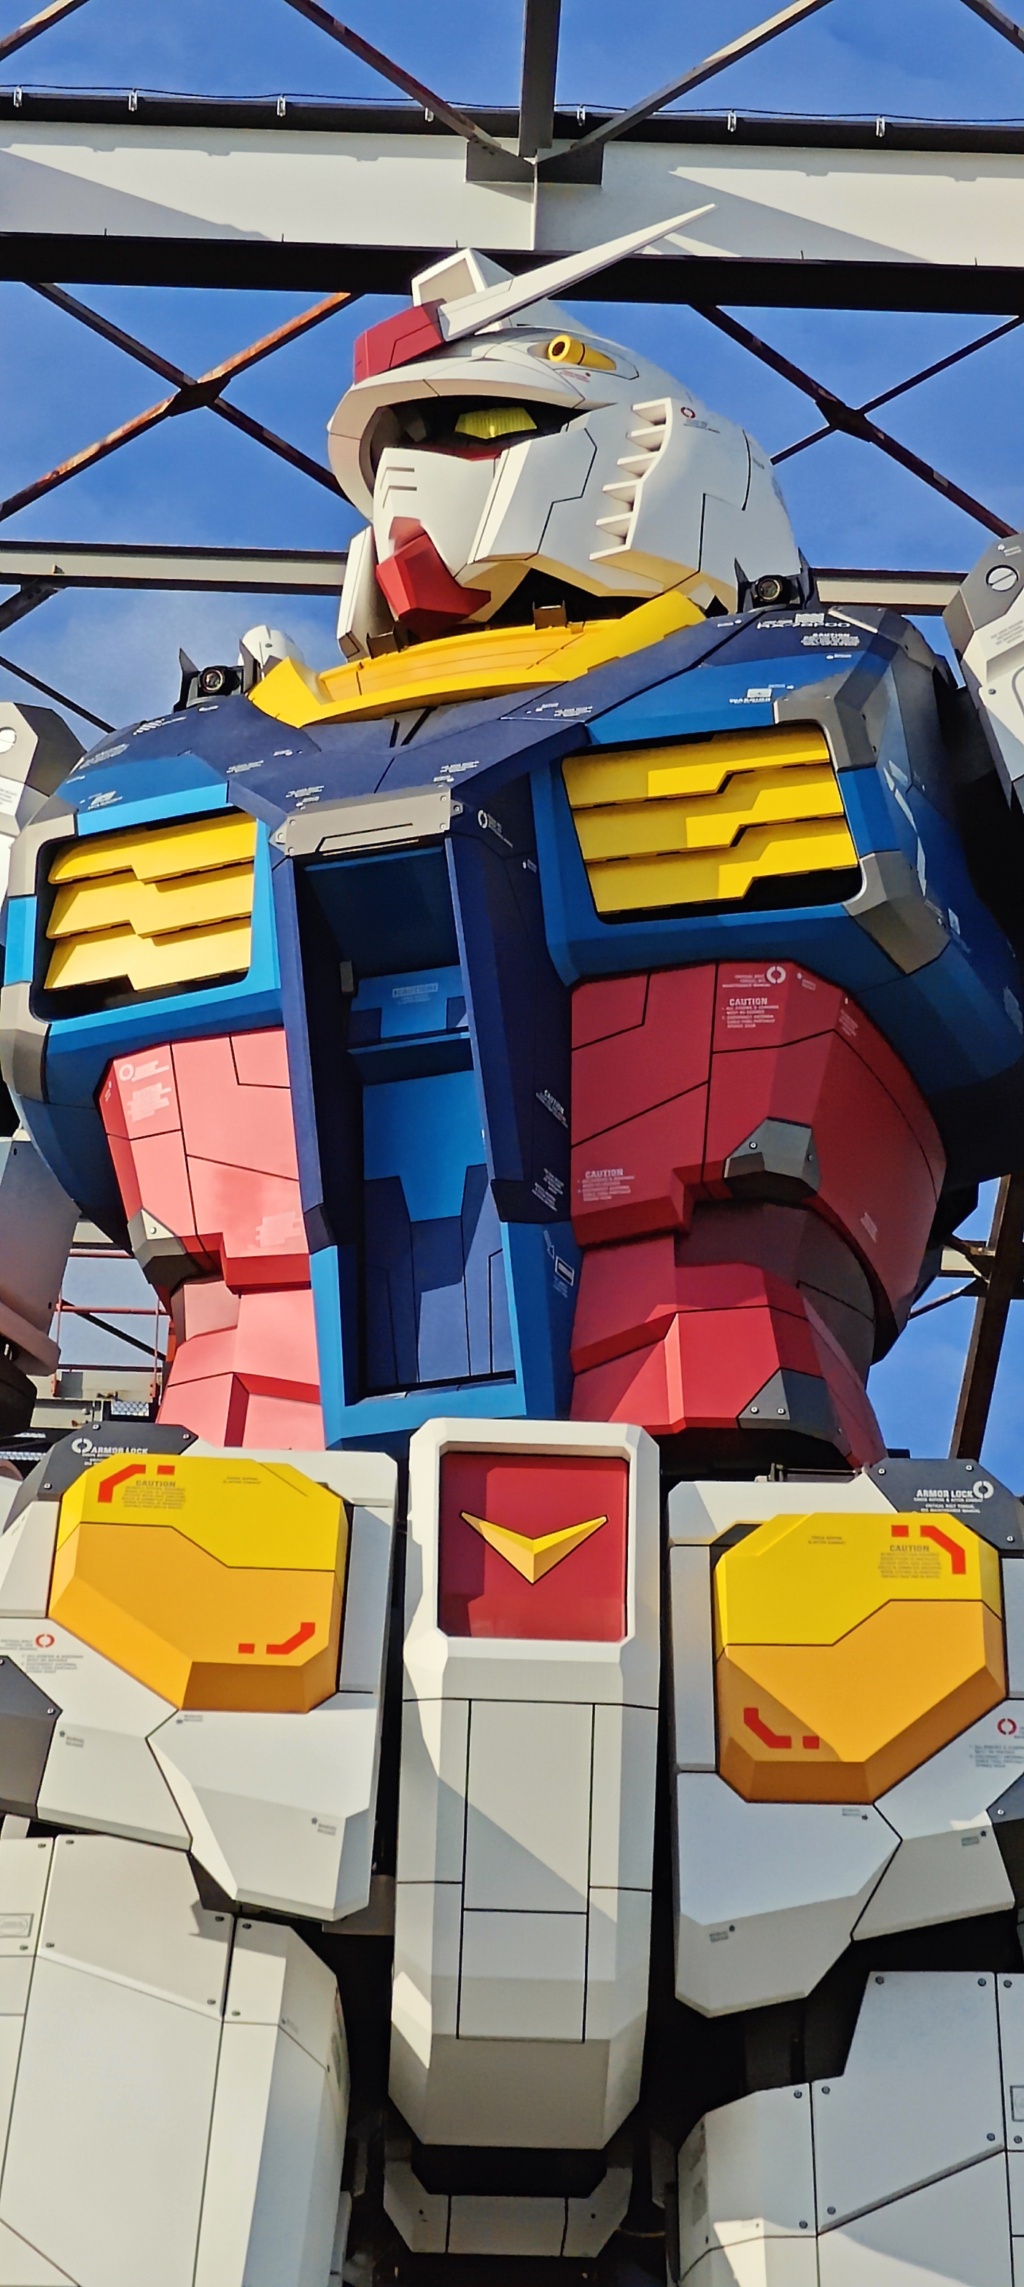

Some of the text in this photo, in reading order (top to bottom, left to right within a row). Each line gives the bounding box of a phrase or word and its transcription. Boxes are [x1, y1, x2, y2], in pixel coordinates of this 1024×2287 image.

[729, 997, 768, 1006] CAUTION
[585, 1168, 624, 1179] CAUTION
[916, 1489, 973, 1498] ARMOR LOCK
[890, 1544, 930, 1552] CAUTION
